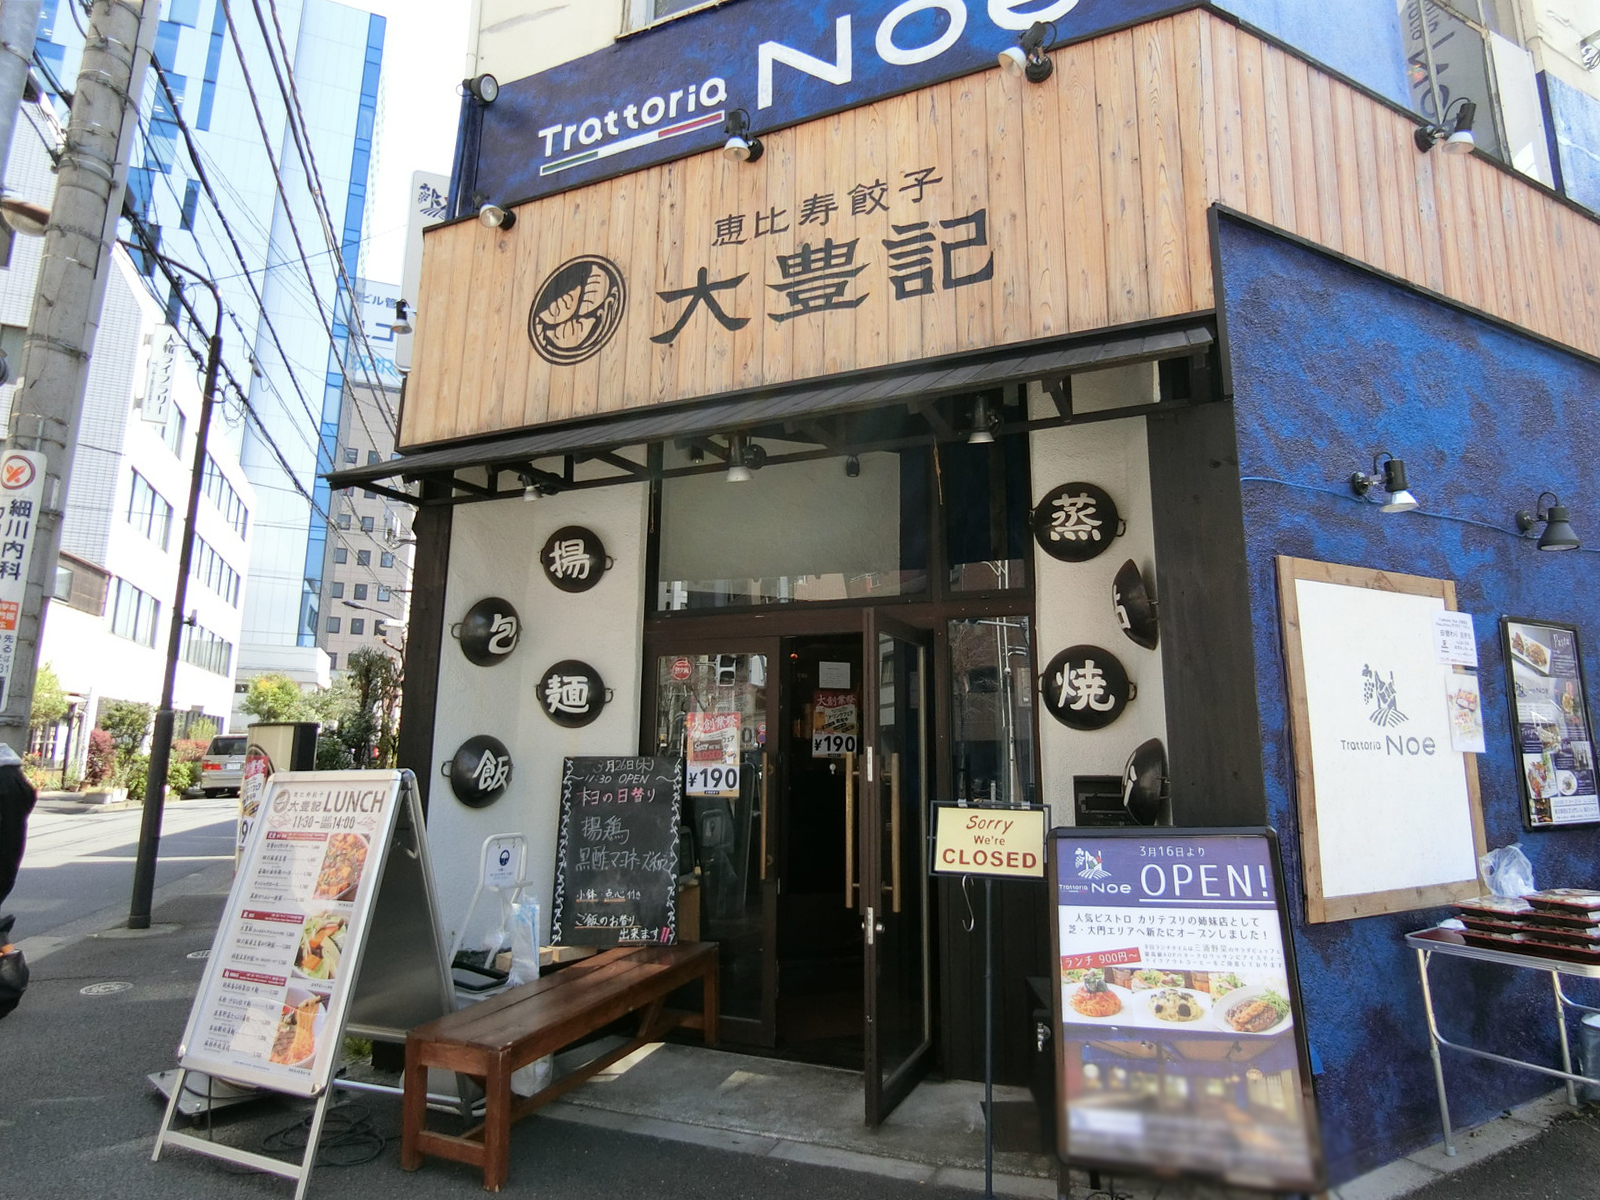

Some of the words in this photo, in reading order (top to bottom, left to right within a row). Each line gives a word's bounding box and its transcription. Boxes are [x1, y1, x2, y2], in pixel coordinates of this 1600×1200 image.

[538, 77, 727, 157] Trattoria
[711, 166, 943, 247] 恵比寿餃子
[650, 208, 993, 344] 大豊記
[1050, 492, 1102, 541] 蒸
[0, 498, 33, 581] 細川内科
[549, 538, 590, 580] 揚
[488, 613, 518, 655] 包
[546, 674, 589, 713] 麺
[1056, 660, 1116, 711] 焼
[814, 736, 856, 752] ¥190
[1341, 739, 1381, 751] Trattoria
[1385, 735, 1436, 756] Noe
[472, 749, 509, 792] 飯
[585, 774, 612, 784] 11:30
[619, 773, 649, 784] OPEN
[688, 768, 738, 789] ¥190
[323, 790, 386, 813] LUNCH
[581, 815, 630, 845] 揚鶏
[966, 815, 1014, 835] Sorry
[973, 835, 1006, 845] We're
[1139, 846, 1206, 857] 3月16日より
[942, 848, 1037, 869] CLOSED
[1091, 882, 1132, 894] Noe
[1140, 863, 1269, 898] OPEN!
[1075, 912, 1132, 924] 人気ビストロ
[1064, 955, 1094, 968] ランチ
